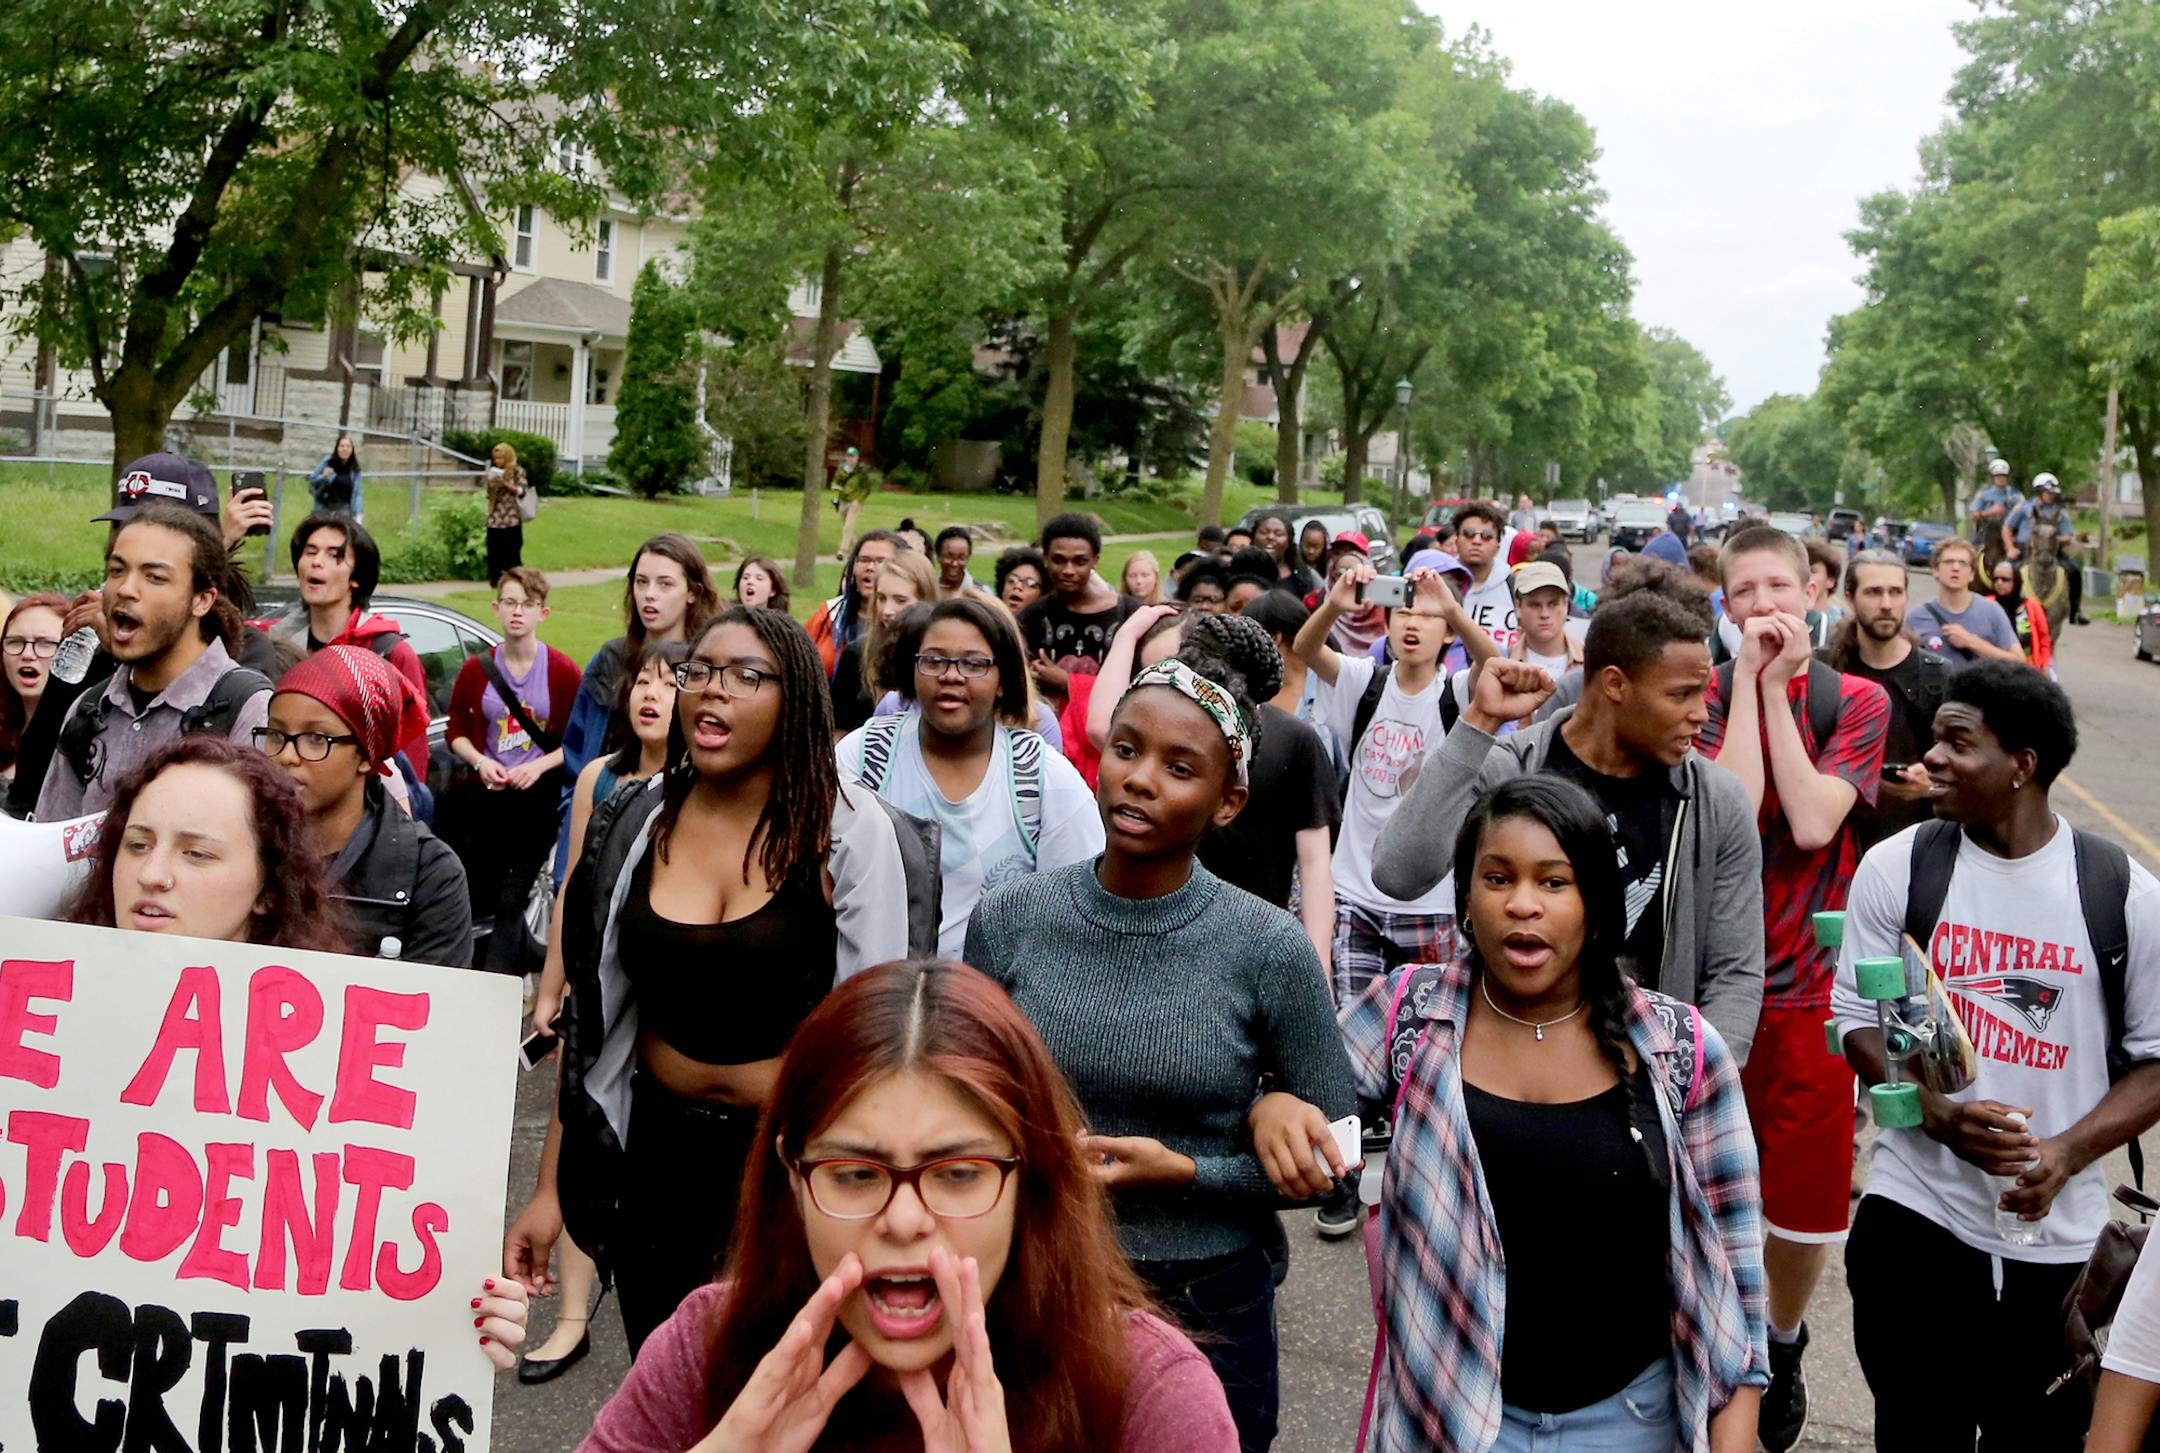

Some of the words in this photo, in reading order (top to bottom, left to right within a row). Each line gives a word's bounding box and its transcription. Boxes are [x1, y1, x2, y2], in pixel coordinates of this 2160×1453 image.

[1931, 921, 2083, 982] CENTRAL
[0, 959, 75, 1090] E
[120, 965, 431, 1133] ARE
[1947, 991, 2070, 1070] NUTEMEN
[0, 1110, 449, 1301] TUDENTS
